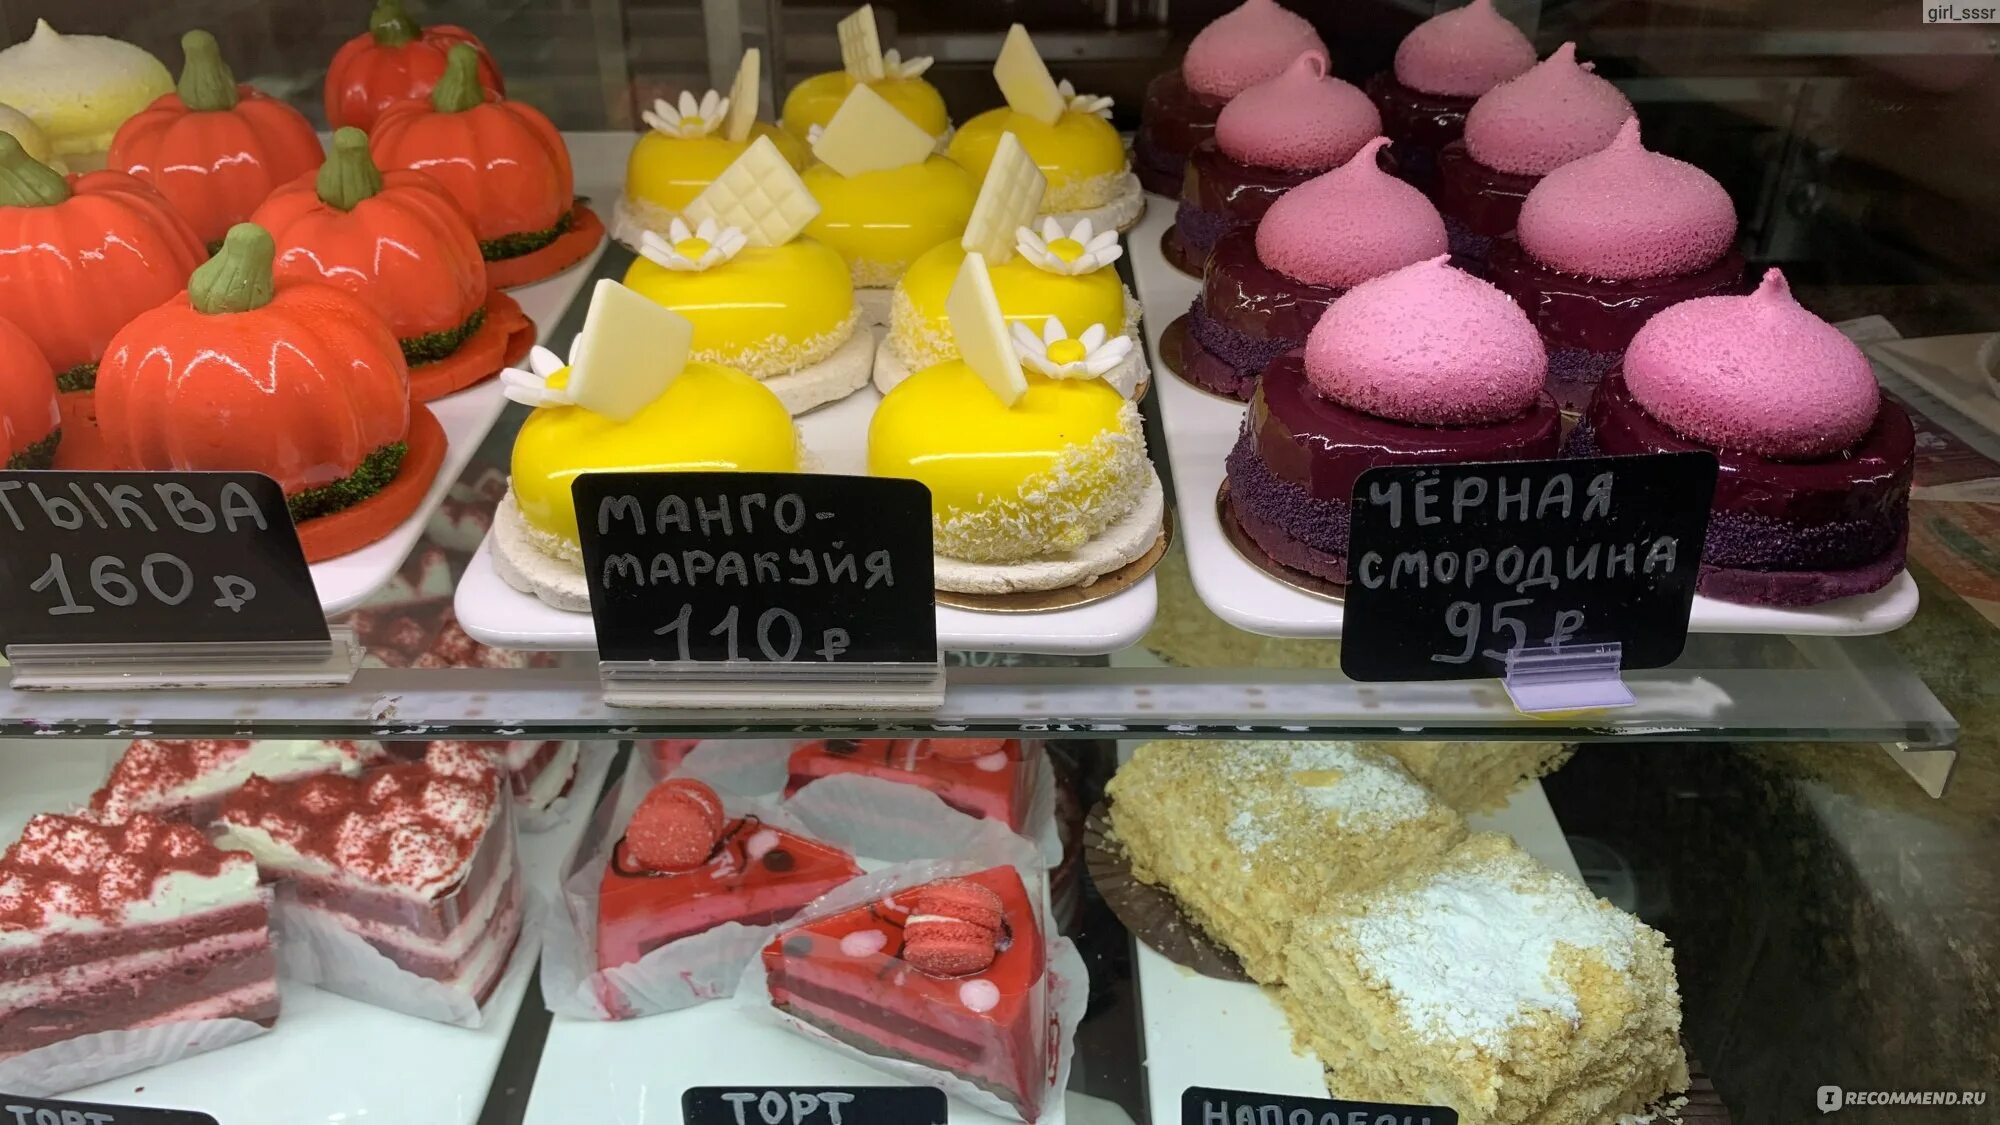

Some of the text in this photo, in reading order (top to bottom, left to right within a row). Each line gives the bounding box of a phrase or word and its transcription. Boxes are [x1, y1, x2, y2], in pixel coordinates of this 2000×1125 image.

[0, 480, 268, 533] ТЫКВА
[598, 493, 835, 536] МАНГО-
[1369, 470, 1614, 528] ЧЁРНАЯ
[602, 541, 894, 589] МАРАКУЙЯ
[1358, 535, 1679, 593] СМОРОДИНА
[721, 1090, 855, 1125] ТОРТ
